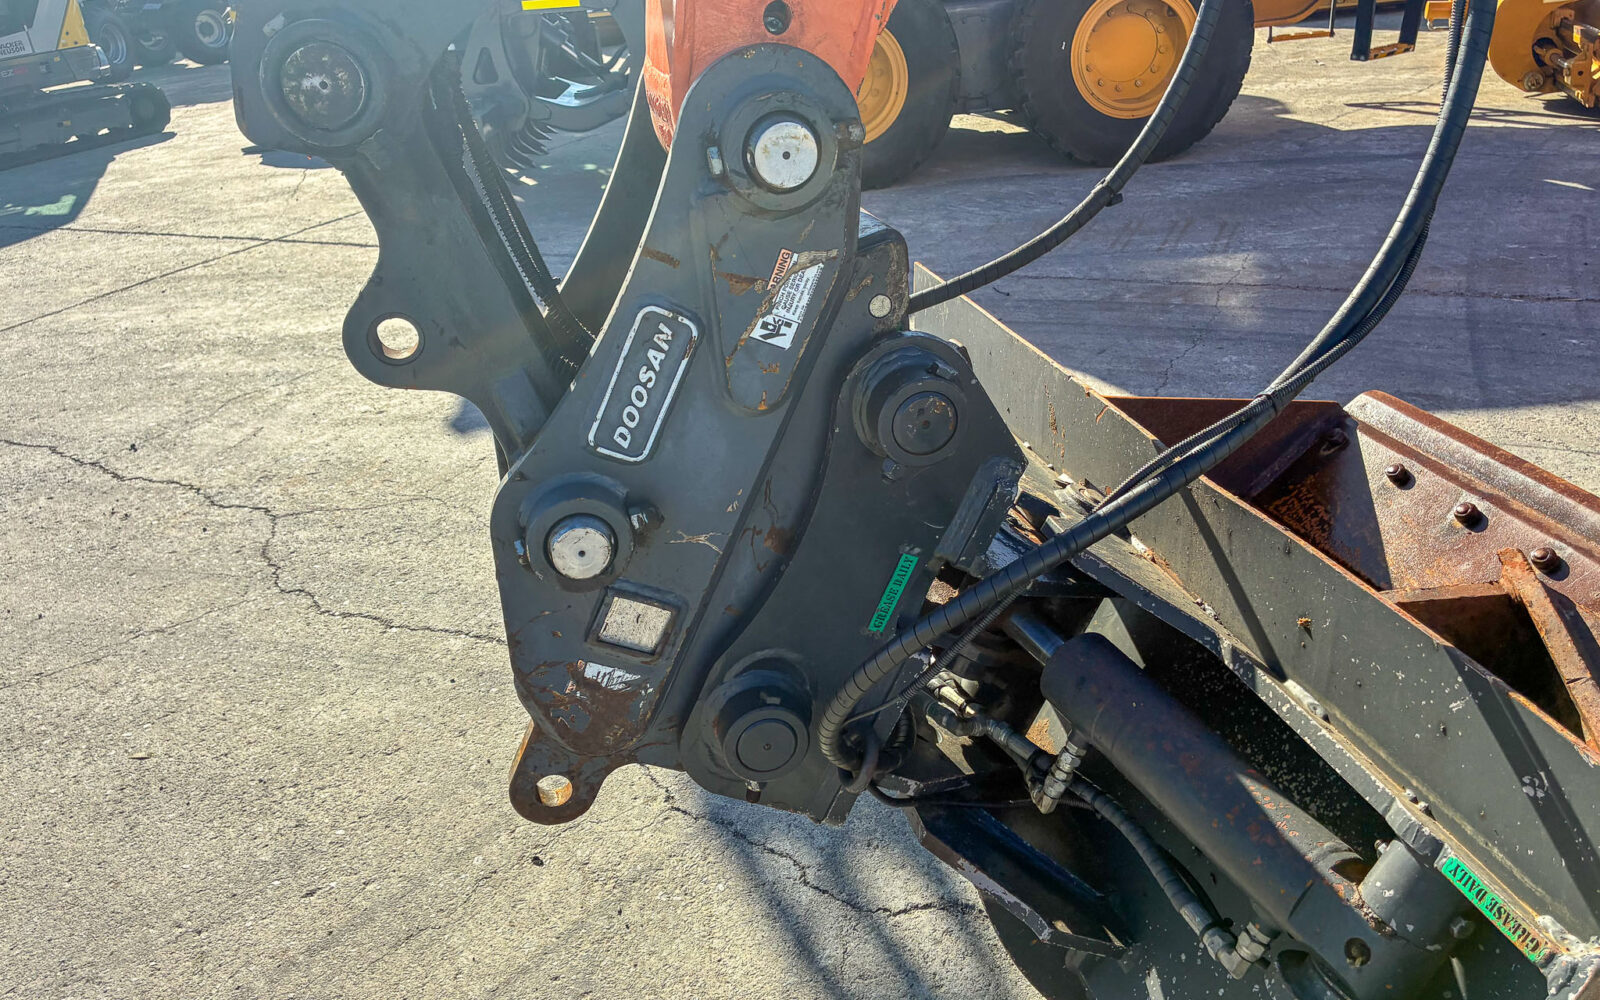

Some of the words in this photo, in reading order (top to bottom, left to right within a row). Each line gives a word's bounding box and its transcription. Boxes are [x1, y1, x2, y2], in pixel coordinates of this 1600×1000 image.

[0, 40, 24, 50] ACKER
[775, 290, 785, 310] PINCH
[782, 274, 793, 291] POIN
[781, 288, 791, 310] CAUSE
[788, 271, 799, 290] SERIO
[785, 291, 796, 313] INJURY
[793, 281, 801, 293] OR
[797, 269, 806, 283] DEA
[613, 322, 673, 449] DOOSAN
[873, 588, 899, 628] GREASE
[893, 556, 913, 587] DAILY
[1448, 864, 1487, 902] DAILY
[1485, 897, 1540, 952] GREASE
